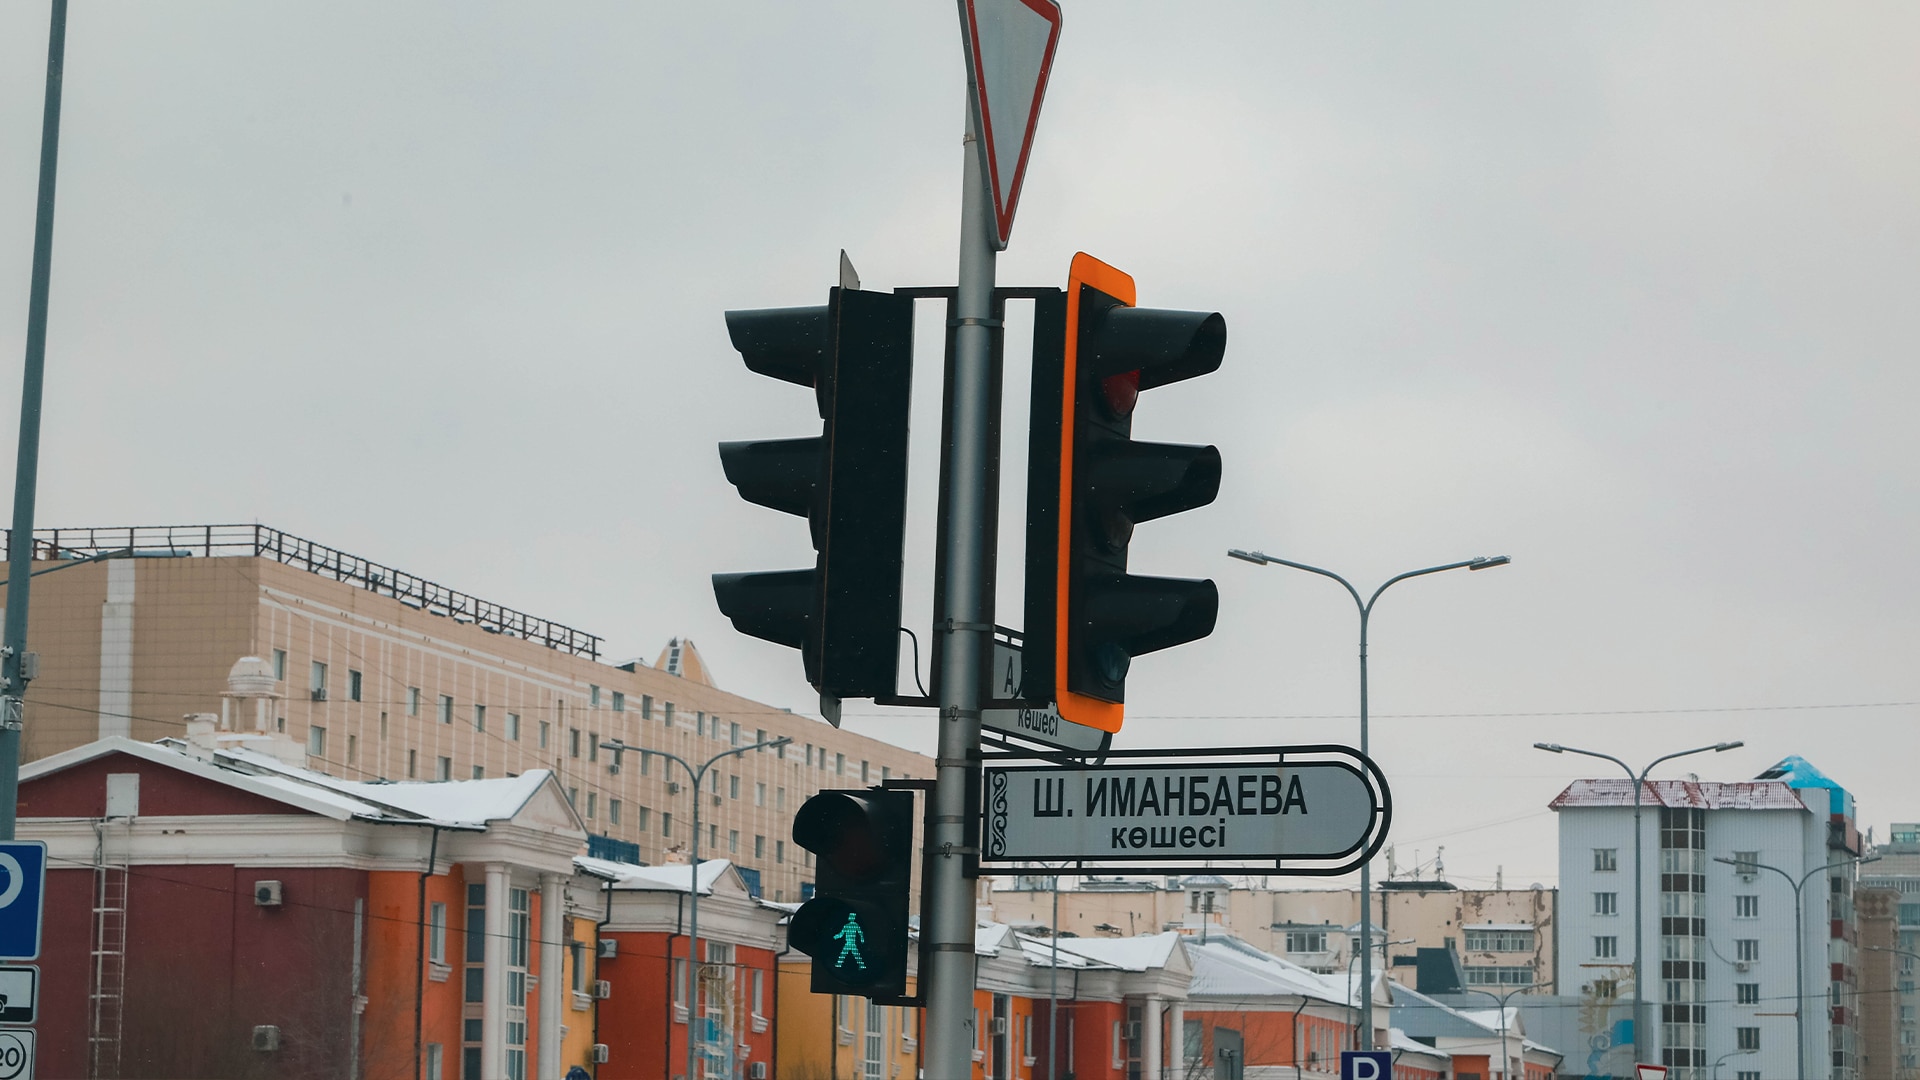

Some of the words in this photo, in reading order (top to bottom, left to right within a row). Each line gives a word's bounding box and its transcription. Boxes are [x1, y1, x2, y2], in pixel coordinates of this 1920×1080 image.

[1018, 708, 1059, 737] көшесі
[1034, 777, 1073, 817] Ш.
[1086, 774, 1308, 817] ИМАНБАЕВА
[1111, 818, 1226, 849] көшесі
